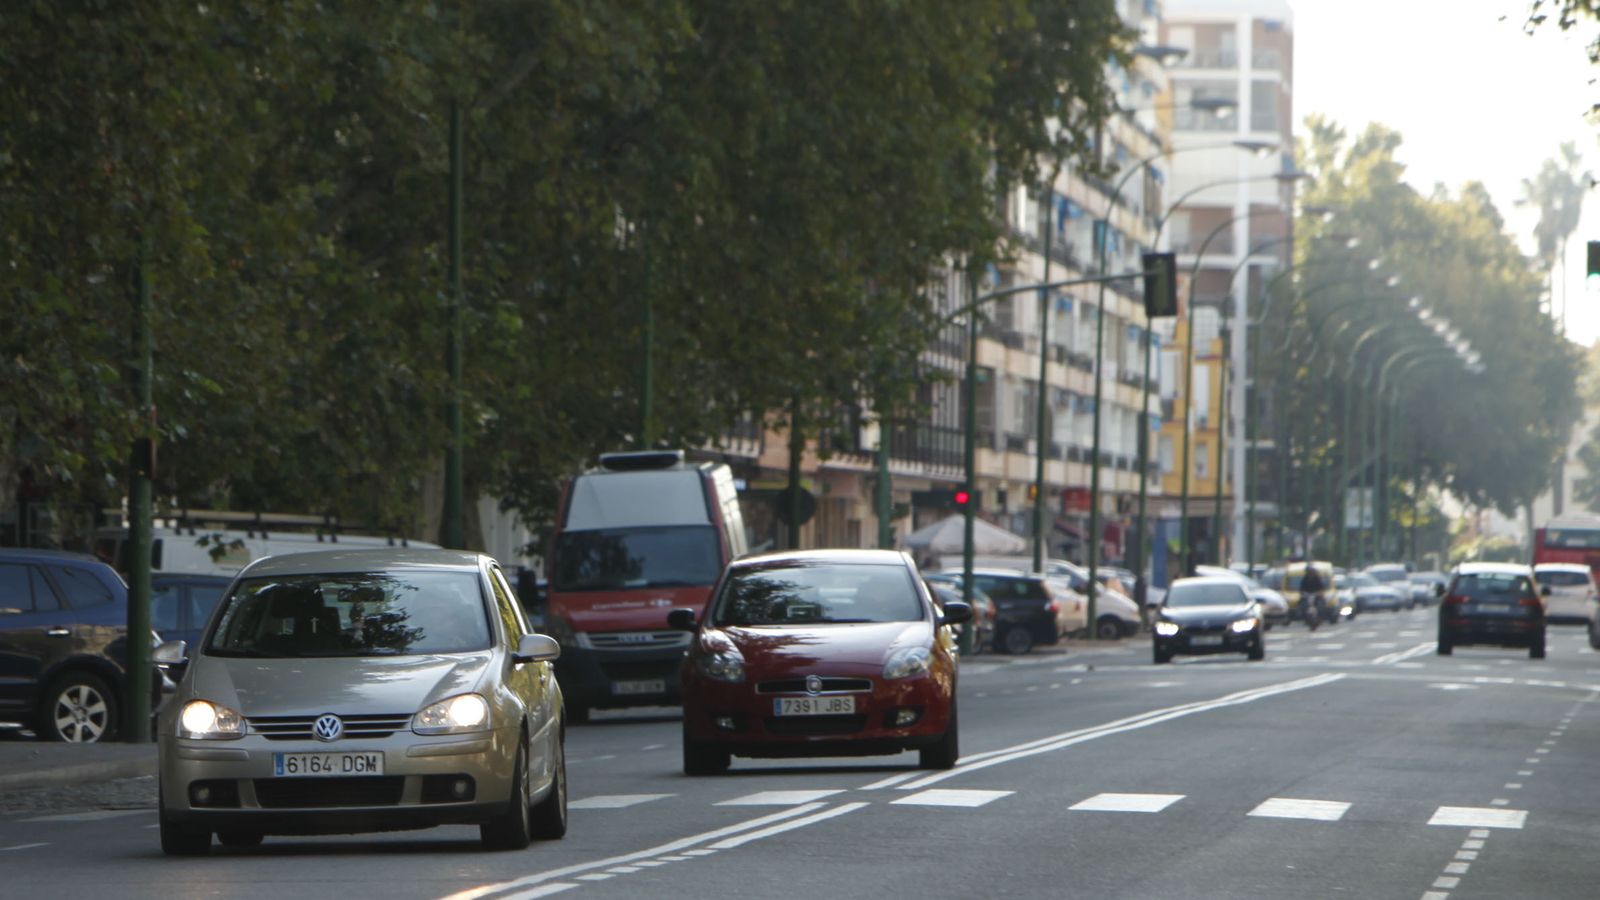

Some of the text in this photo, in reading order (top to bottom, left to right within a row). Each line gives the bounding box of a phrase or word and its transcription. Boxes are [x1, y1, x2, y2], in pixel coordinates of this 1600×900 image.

[784, 698, 852, 713] 7391 JBS
[287, 755, 377, 773] 6164 DGM
